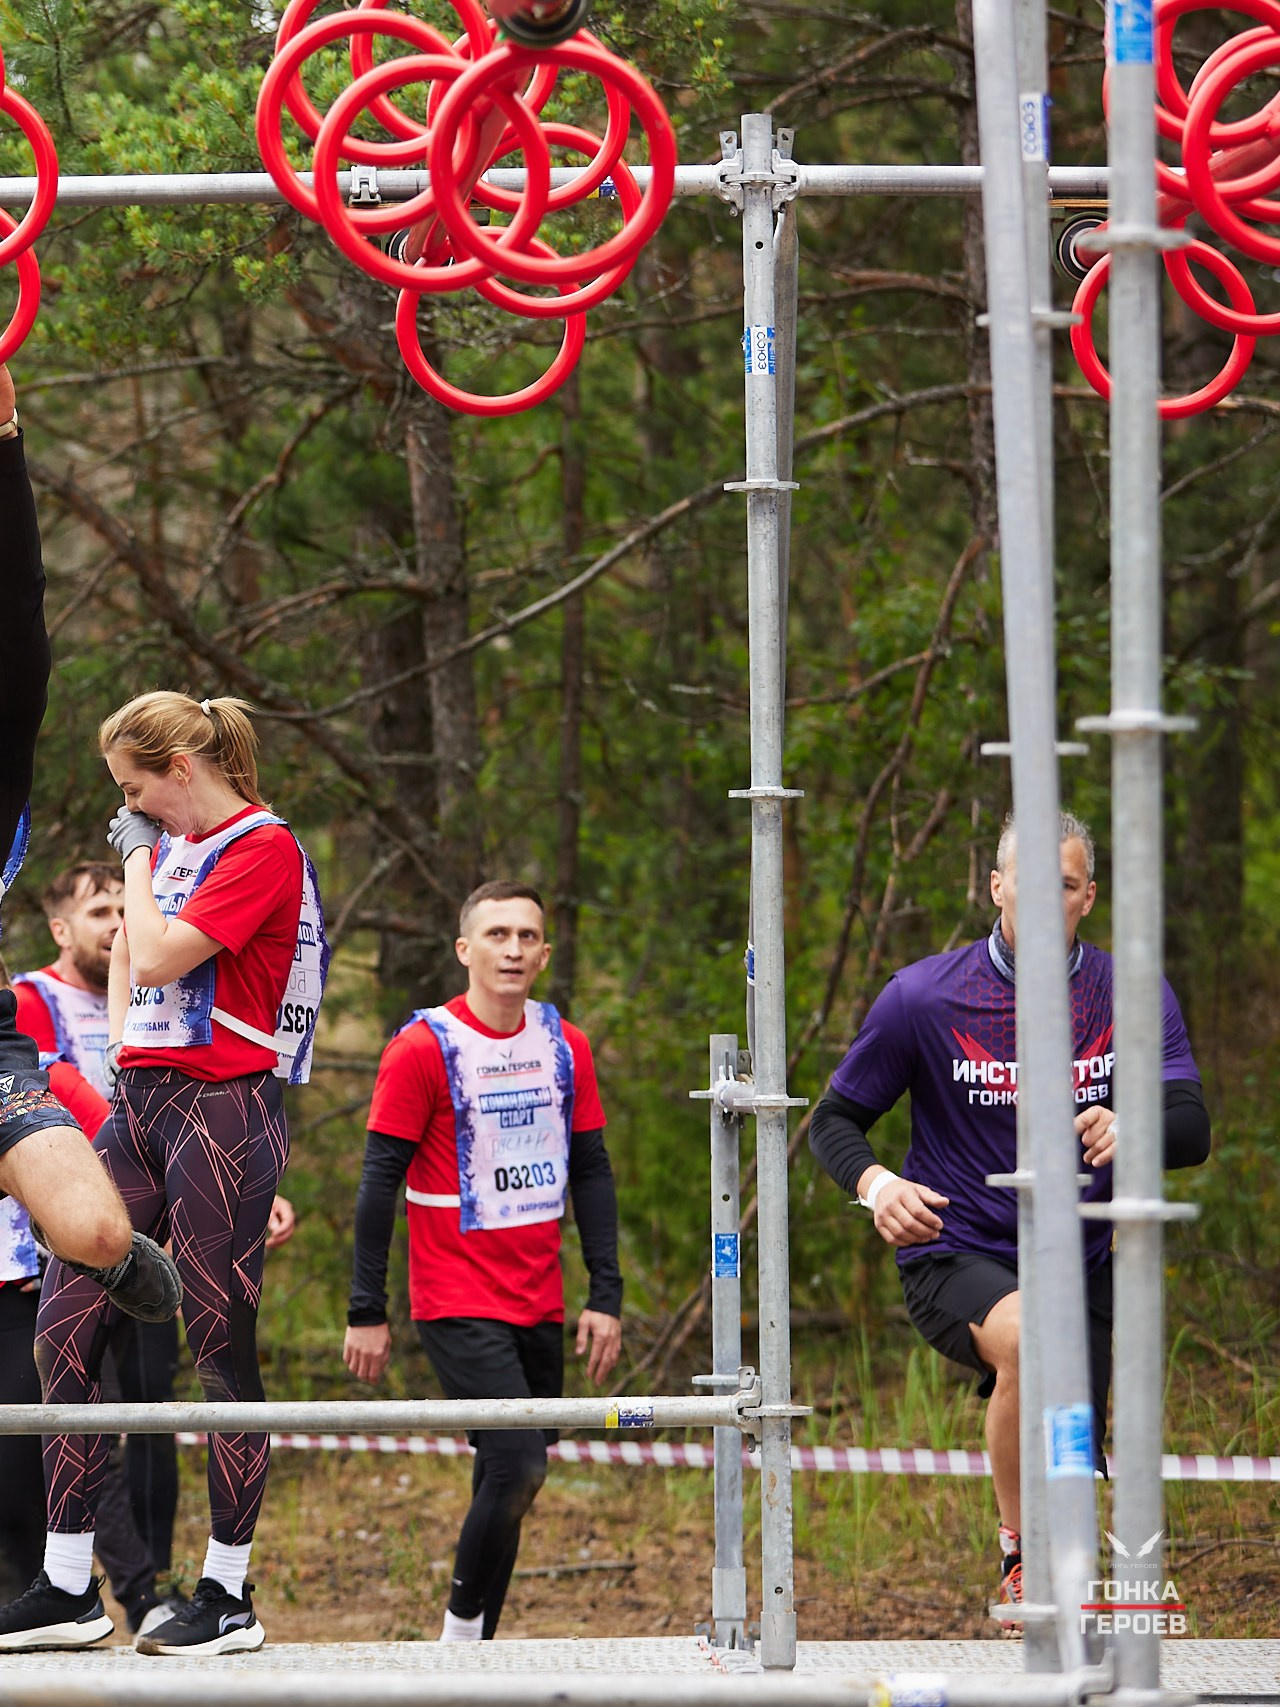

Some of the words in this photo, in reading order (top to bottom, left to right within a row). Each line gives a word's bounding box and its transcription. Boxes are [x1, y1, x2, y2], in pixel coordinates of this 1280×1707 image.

[757, 331, 767, 369] СОЮЗ
[477, 1065, 506, 1074] ГОНКА
[508, 1060, 541, 1073] ГЕРОЕВ
[953, 1052, 1116, 1084] ИНСТТОР
[480, 1088, 551, 1112] КОМАНДНЫЙ
[969, 1090, 1019, 1106] ГОНК
[502, 1111, 532, 1127] СТАРТ
[495, 1162, 556, 1192] 03203
